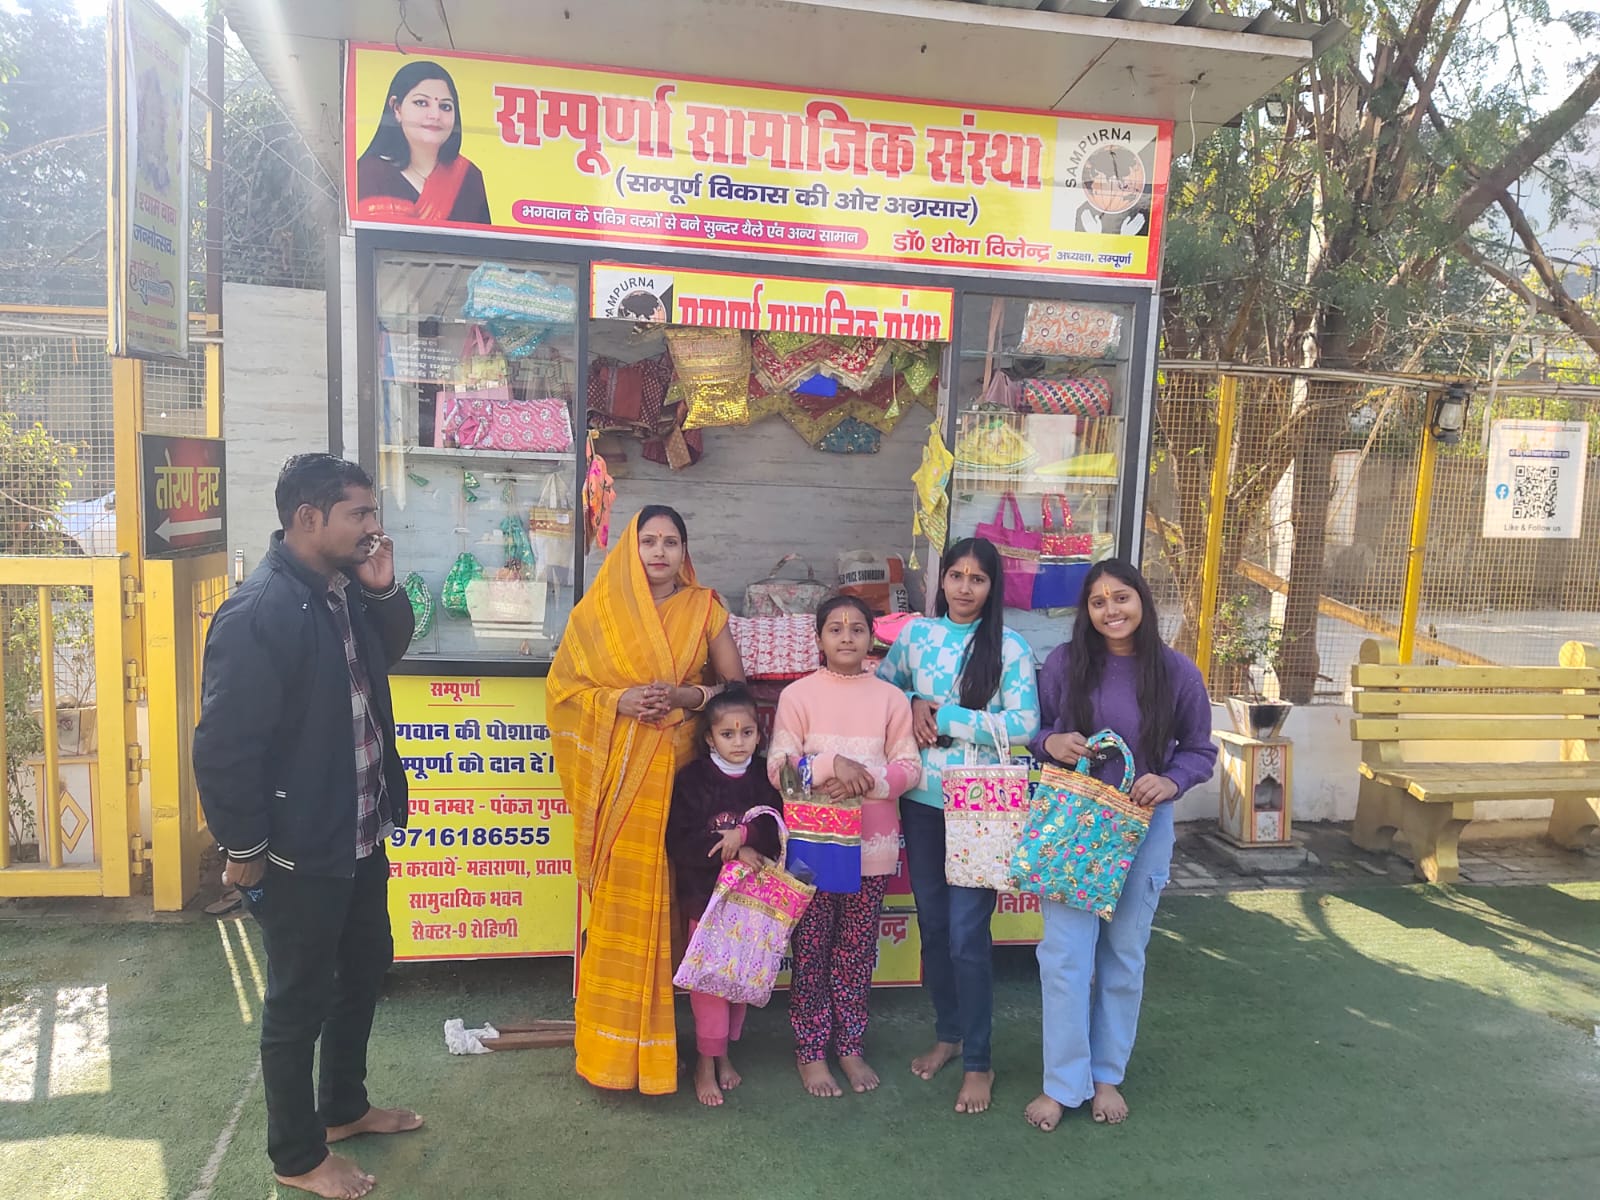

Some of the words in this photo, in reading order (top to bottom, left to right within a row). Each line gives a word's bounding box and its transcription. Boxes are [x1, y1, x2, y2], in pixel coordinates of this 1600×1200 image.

[494, 84, 676, 175] सम्पूर्णा
[686, 100, 917, 179] सामाजिक
[926, 113, 1044, 190] संस्था
[1065, 127, 1132, 188] SAMPURNA
[615, 166, 703, 204] (सम्पूर्ण
[708, 174, 790, 204] विकास
[795, 183, 829, 208] की
[834, 187, 881, 211] ओर
[521, 204, 571, 223] भगवान
[575, 206, 590, 223] के
[593, 207, 626, 226] पवित्र
[629, 211, 662, 229] वस्त्रों
[664, 214, 677, 230] से
[680, 215, 701, 231] बने
[703, 218, 739, 238] सुन्दर
[741, 218, 764, 238] थैले
[787, 226, 816, 241] अन्य
[818, 229, 859, 245] सामान
[931, 231, 981, 256] शोभा
[985, 234, 1053, 263] विजेन्द्र
[604, 276, 655, 318] AMPURNA
[154, 447, 195, 509] तोरण
[196, 466, 221, 512] द्वार
[430, 679, 481, 703] सम्पूर्णा
[395, 723, 451, 741] गवान
[454, 719, 481, 741] की
[486, 719, 551, 741] पोशाक
[400, 751, 455, 780] म्पूर्णा
[457, 751, 485, 774] को
[489, 756, 526, 774] दान
[434, 798, 475, 816] नम्बर
[490, 793, 534, 816] पंकज
[390, 826, 551, 848] 9716186555
[389, 862, 403, 878] ल
[535, 859, 573, 876] प्रताप
[408, 887, 487, 915] सामुदायिक
[489, 890, 523, 907] भवन
[470, 917, 519, 938] रोहिणी
